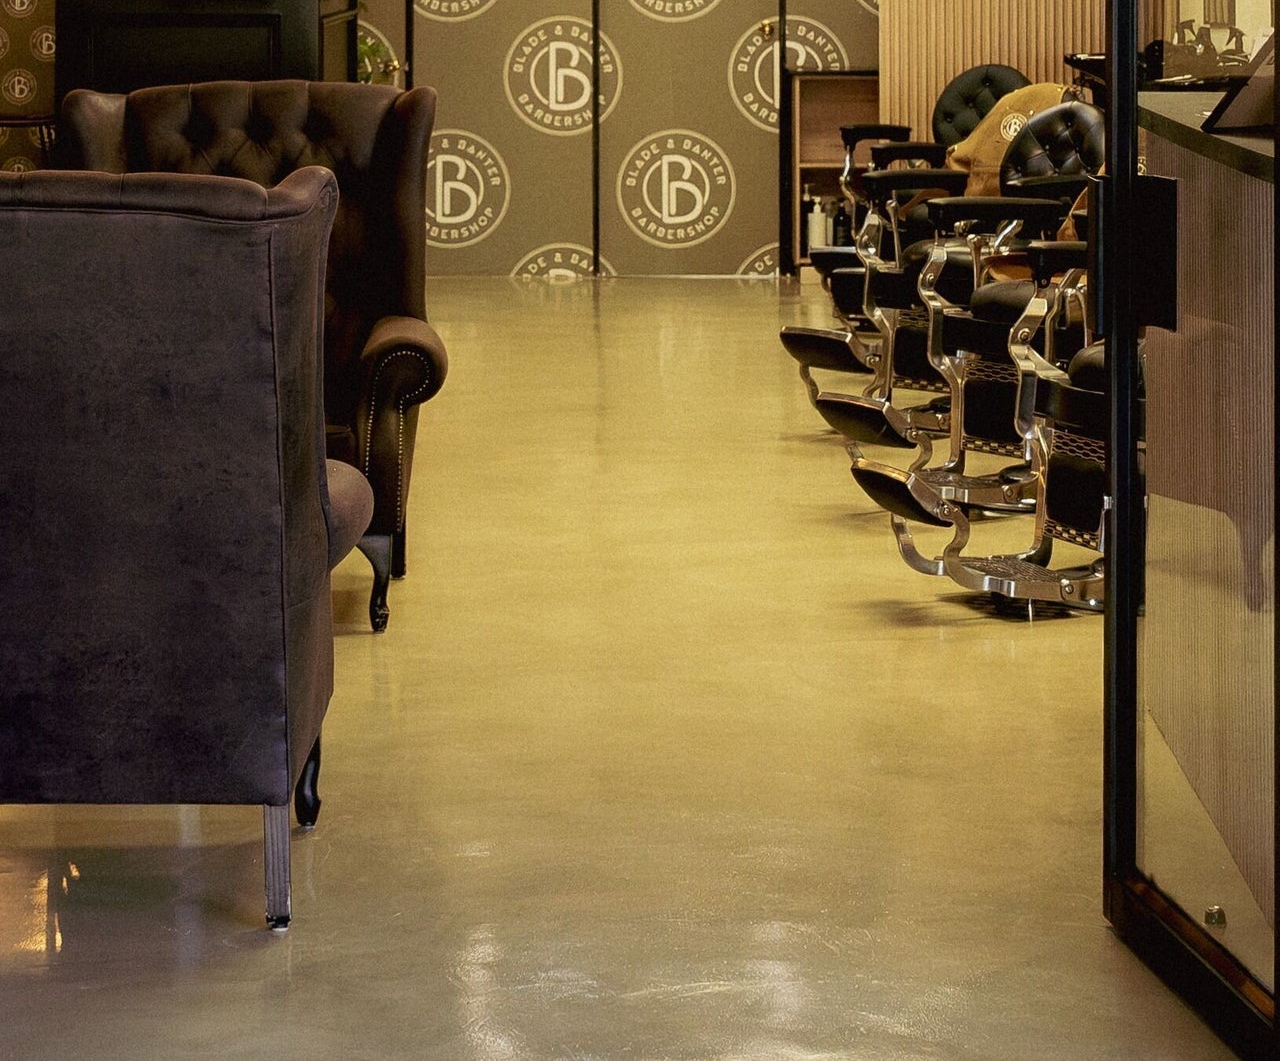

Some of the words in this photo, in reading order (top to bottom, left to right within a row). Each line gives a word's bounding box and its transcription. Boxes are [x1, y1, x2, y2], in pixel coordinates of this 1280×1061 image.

[513, 30, 547, 73] BLADE
[737, 35, 762, 72] BLAD
[457, 140, 500, 185] BANTER
[626, 143, 659, 186] BLADE
[683, 139, 726, 185] BANTER
[632, 207, 719, 239] BARBERSHOP
